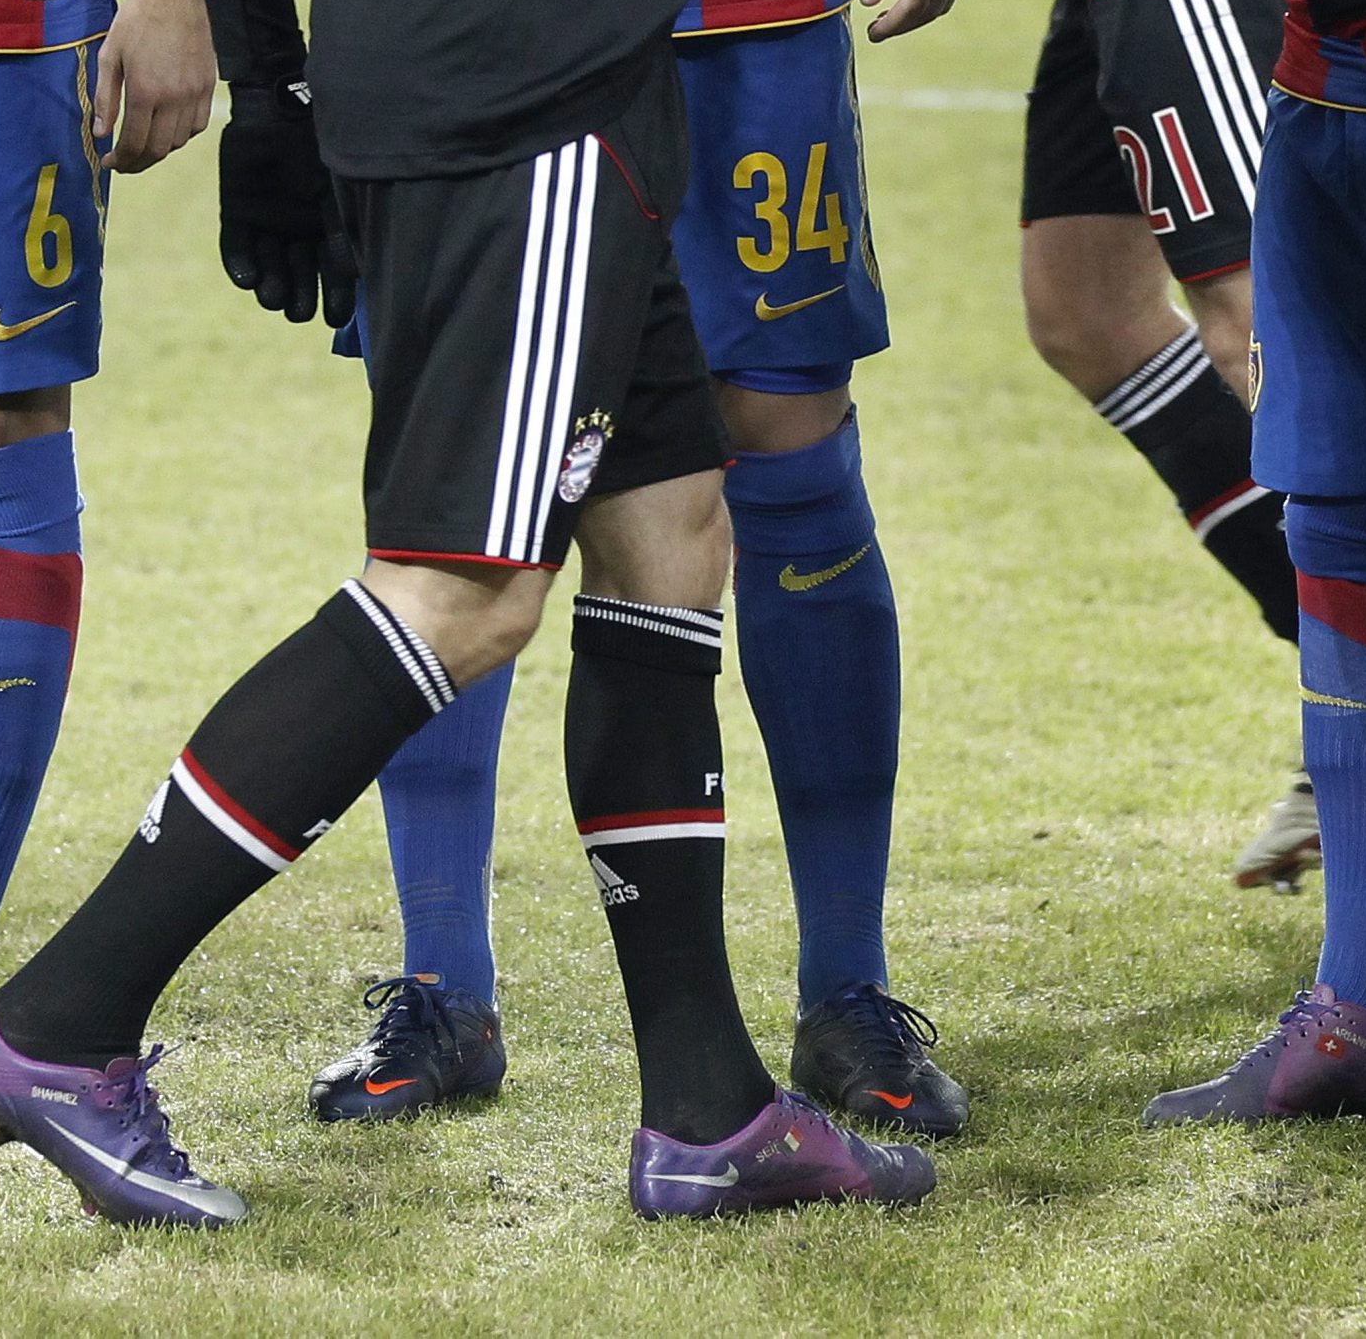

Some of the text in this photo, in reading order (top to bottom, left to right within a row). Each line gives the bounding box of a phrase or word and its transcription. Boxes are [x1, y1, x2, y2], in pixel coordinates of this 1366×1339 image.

[24, 163, 74, 288] 6
[733, 142, 852, 273] 34
[1113, 106, 1214, 234] 21
